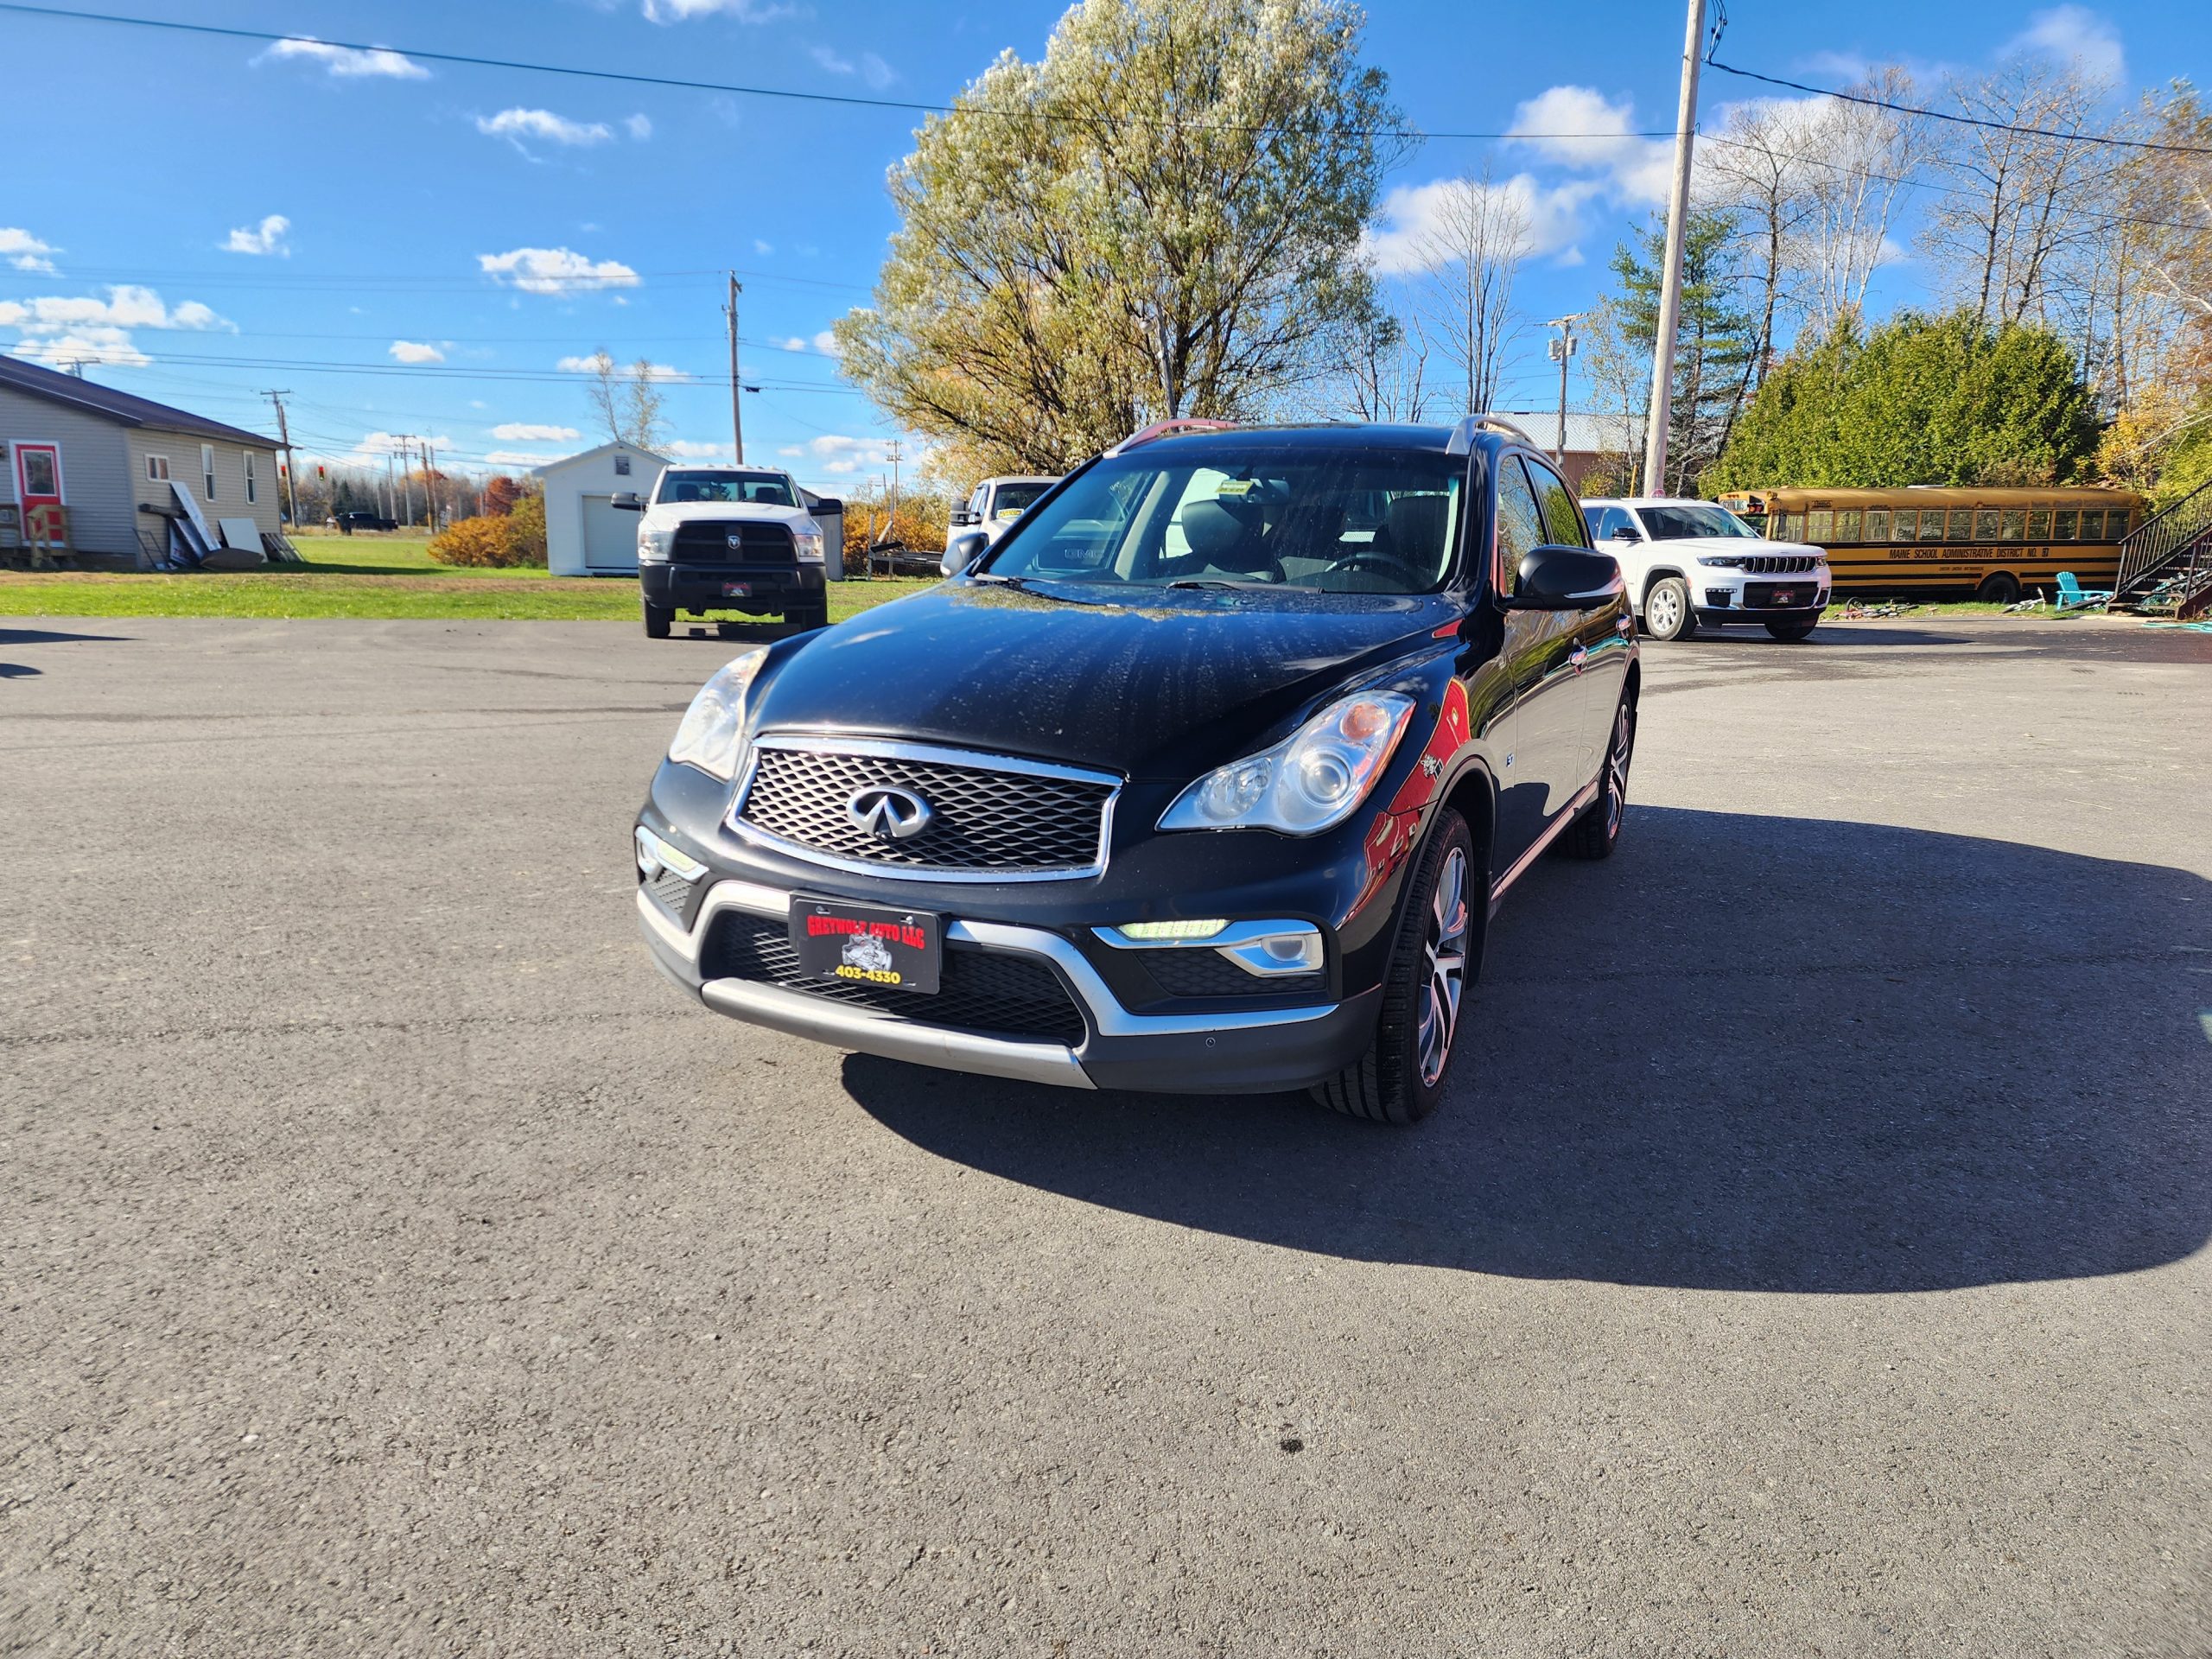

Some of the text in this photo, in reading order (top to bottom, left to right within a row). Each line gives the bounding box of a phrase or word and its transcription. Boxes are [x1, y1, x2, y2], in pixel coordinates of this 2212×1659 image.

[1889, 549, 1910, 559] MAINE
[1914, 549, 1938, 558] SCHOOL
[1942, 548, 1993, 558] ADMINISTRATIVE
[1996, 548, 2024, 557] DISTRICT
[808, 916, 925, 949] GREYWOLF AUTO LLC
[836, 965, 900, 983] 403-4330
